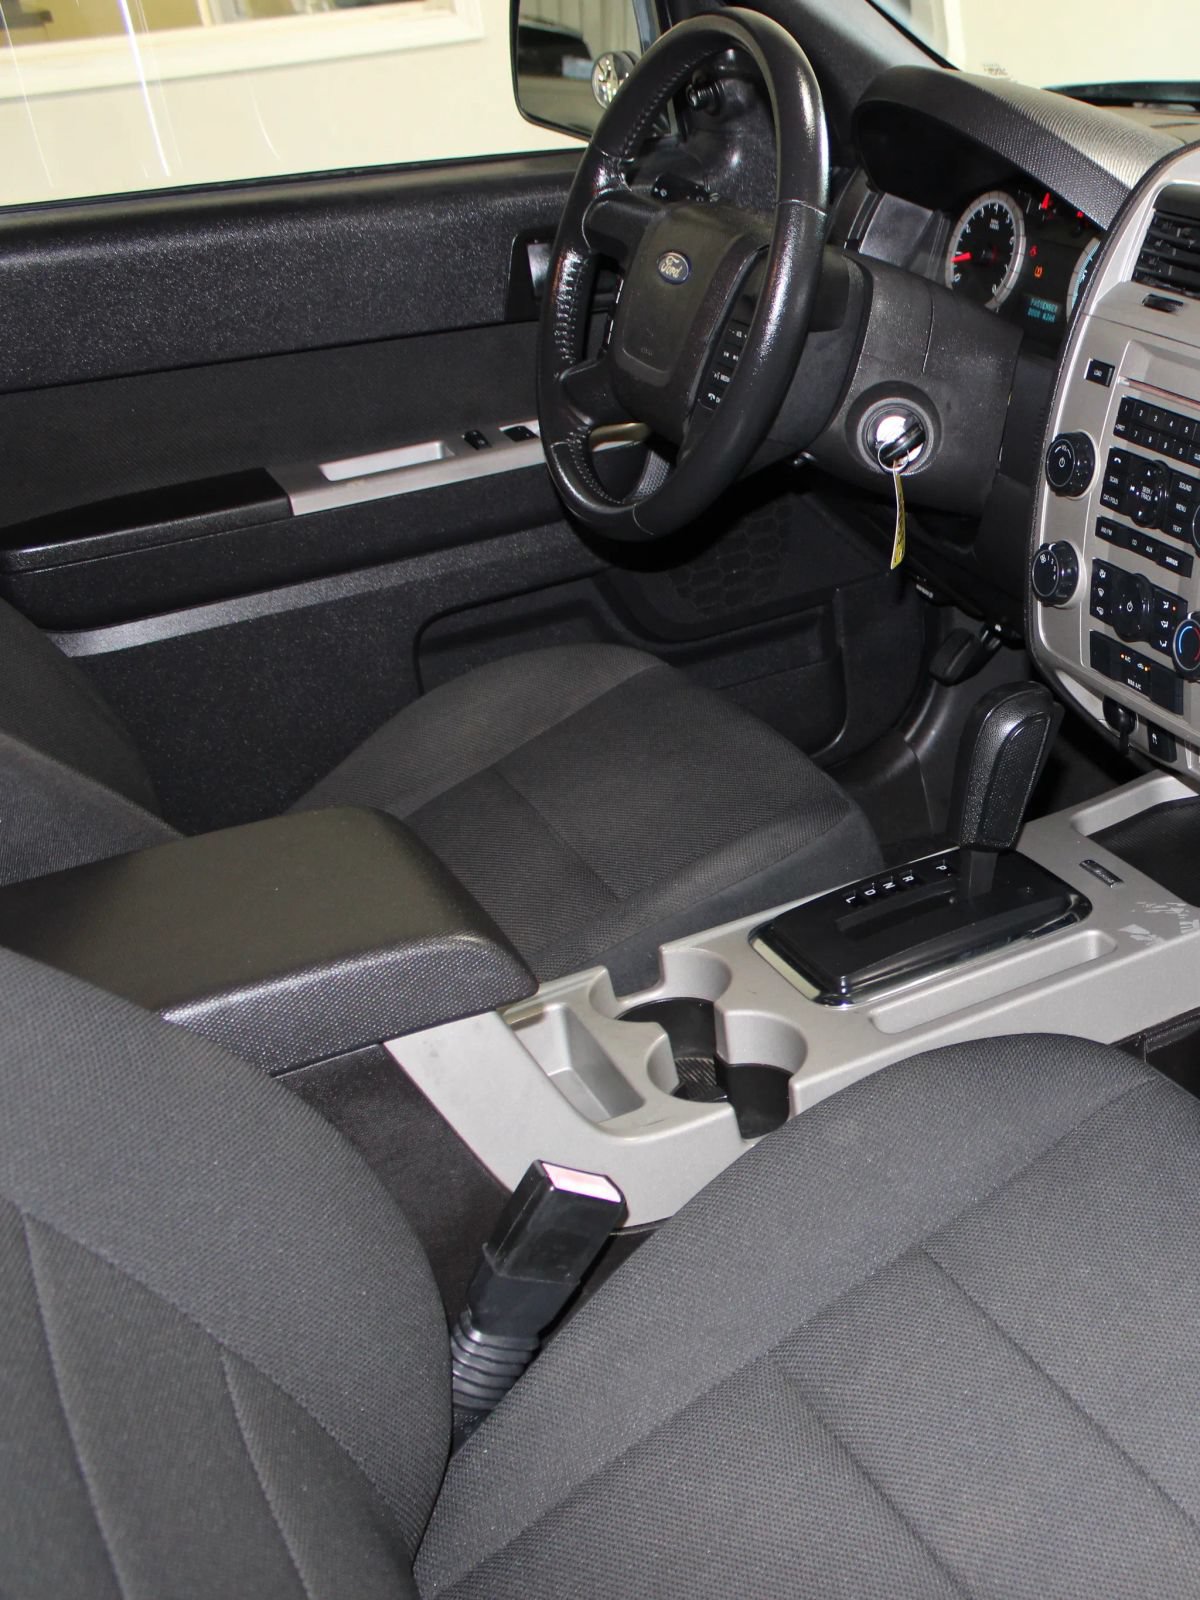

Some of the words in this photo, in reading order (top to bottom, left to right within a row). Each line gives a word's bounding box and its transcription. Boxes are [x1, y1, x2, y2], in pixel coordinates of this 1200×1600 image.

[660, 255, 684, 278] Ford
[1178, 481, 1192, 493] SOUND
[864, 888, 877, 896] D
[845, 896, 856, 904] L
